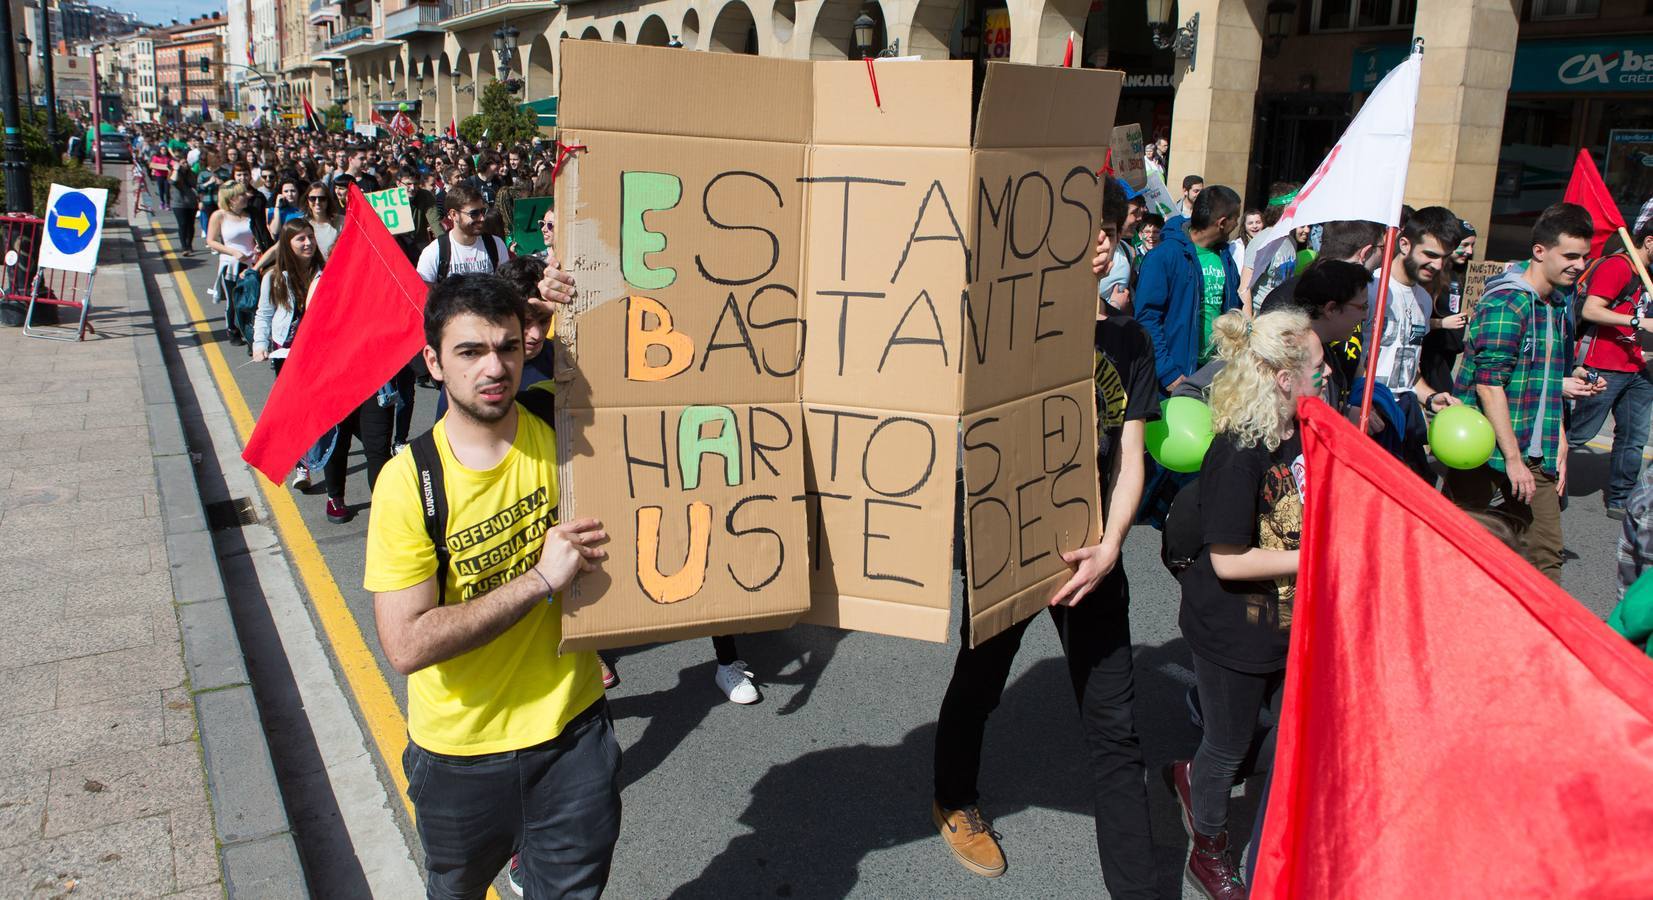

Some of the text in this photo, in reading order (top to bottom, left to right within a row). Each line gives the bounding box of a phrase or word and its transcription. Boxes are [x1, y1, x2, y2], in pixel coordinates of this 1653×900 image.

[1620, 49, 1653, 72] ba
[366, 187, 409, 208] MCE
[619, 165, 1099, 291] ESTAMOS
[1469, 263, 1503, 275] NUESTRO
[619, 263, 1072, 382] BASTANTE
[622, 403, 1001, 499] HARTOS
[421, 470, 436, 517] QUIKSILVER
[449, 500, 532, 551] DEFENDER
[635, 463, 1091, 605] USTEDES
[459, 536, 526, 577] ALEGRIA
